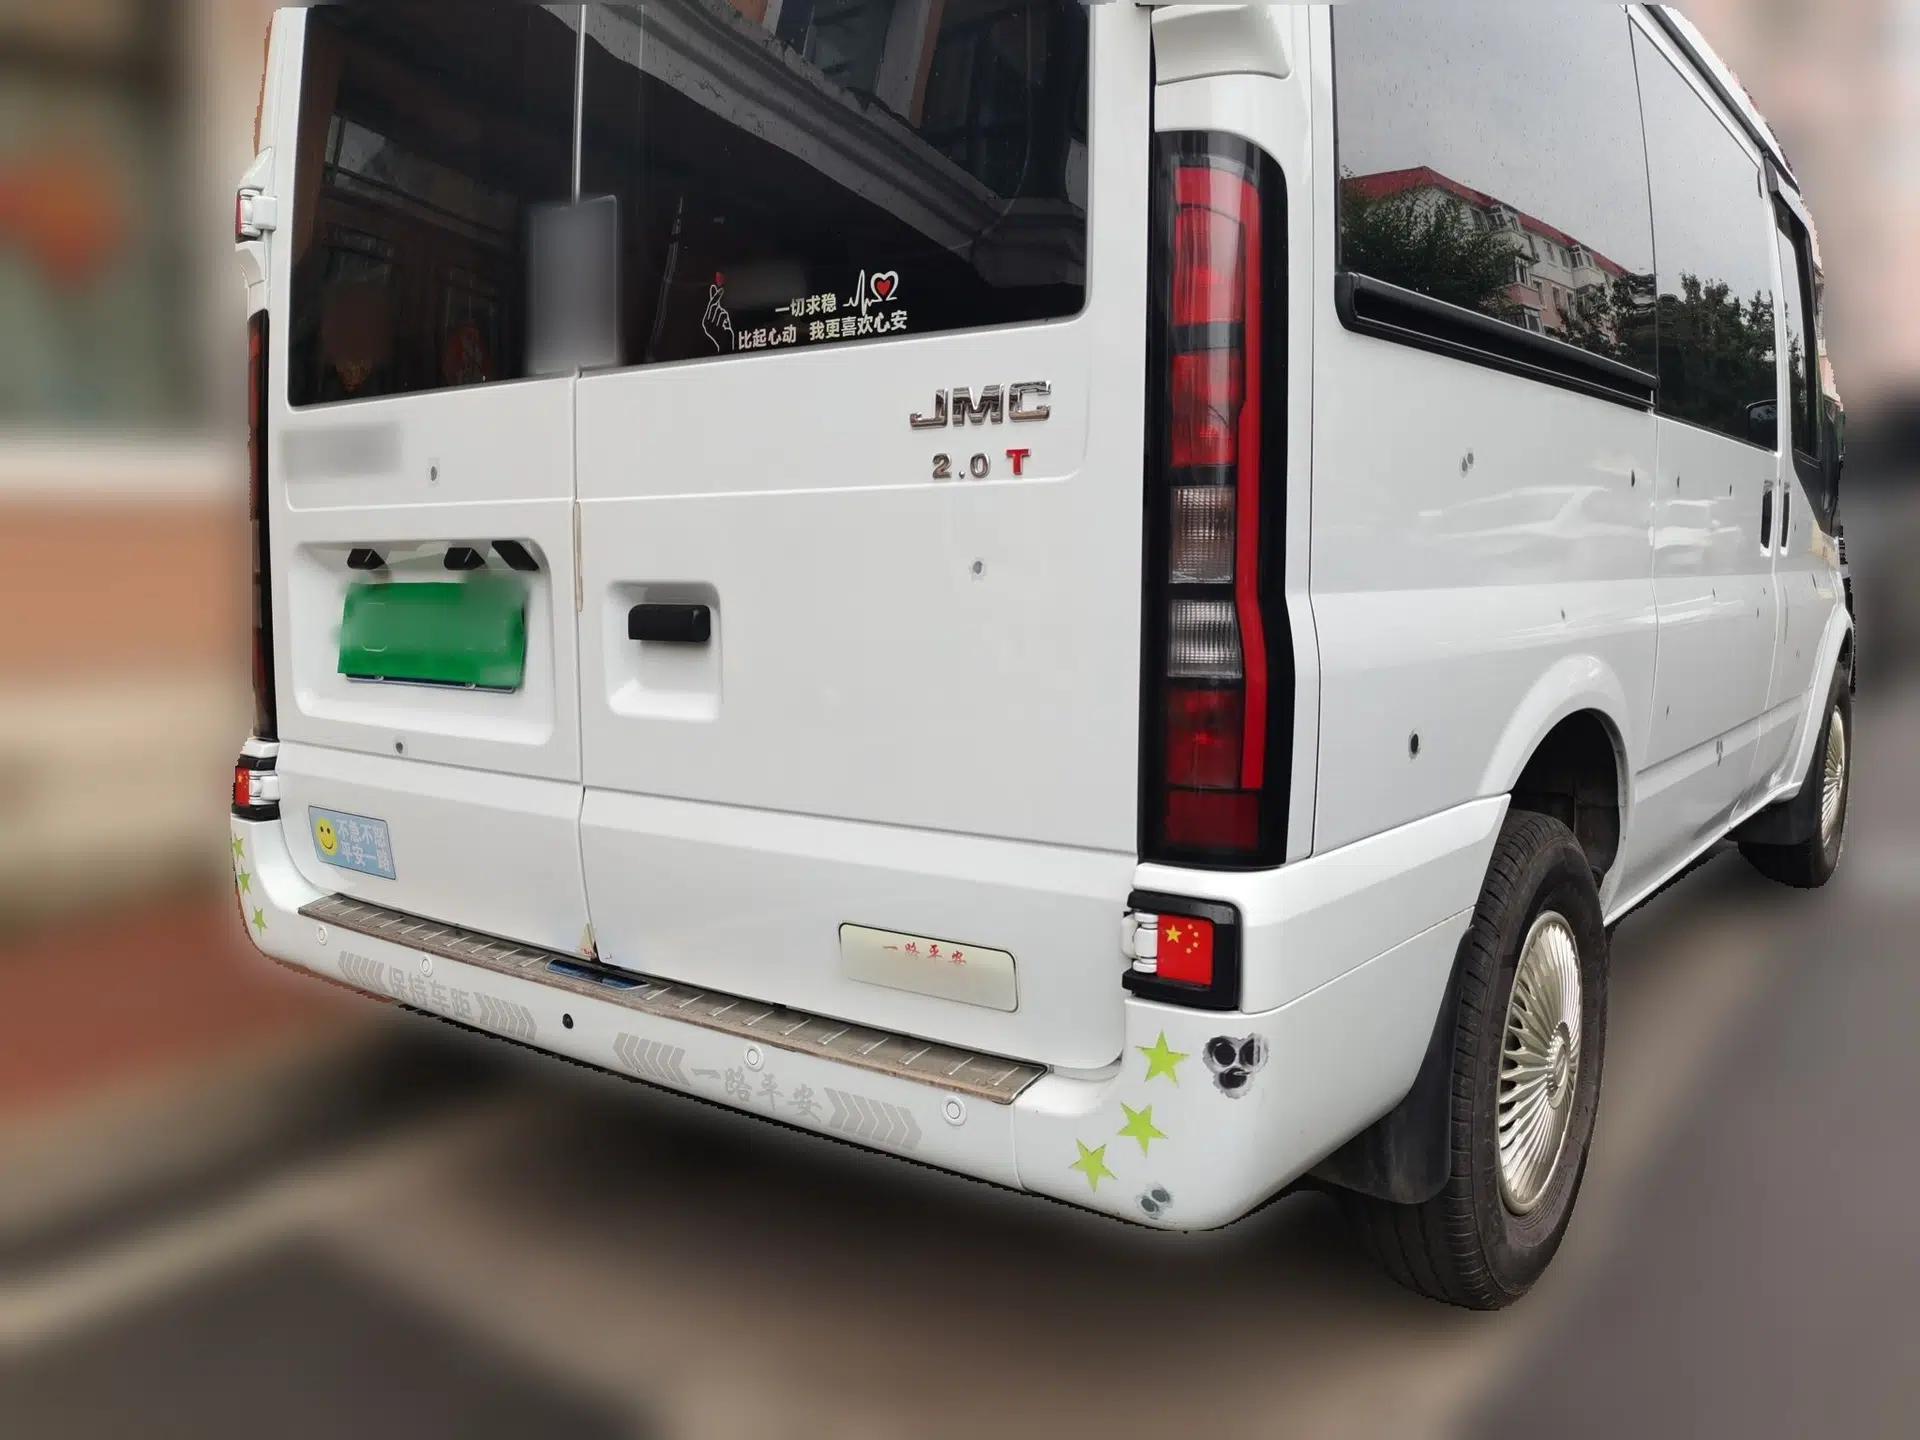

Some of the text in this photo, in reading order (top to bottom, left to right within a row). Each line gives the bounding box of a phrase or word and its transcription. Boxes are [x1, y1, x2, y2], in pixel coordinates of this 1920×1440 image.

[738, 310, 908, 350] 比起心动 我更喜欢心安
[775, 293, 837, 317] 一切求稳
[909, 380, 1051, 430] JMC
[391, 966, 475, 1020] 保持车距
[691, 1066, 822, 1122] 一路平安
